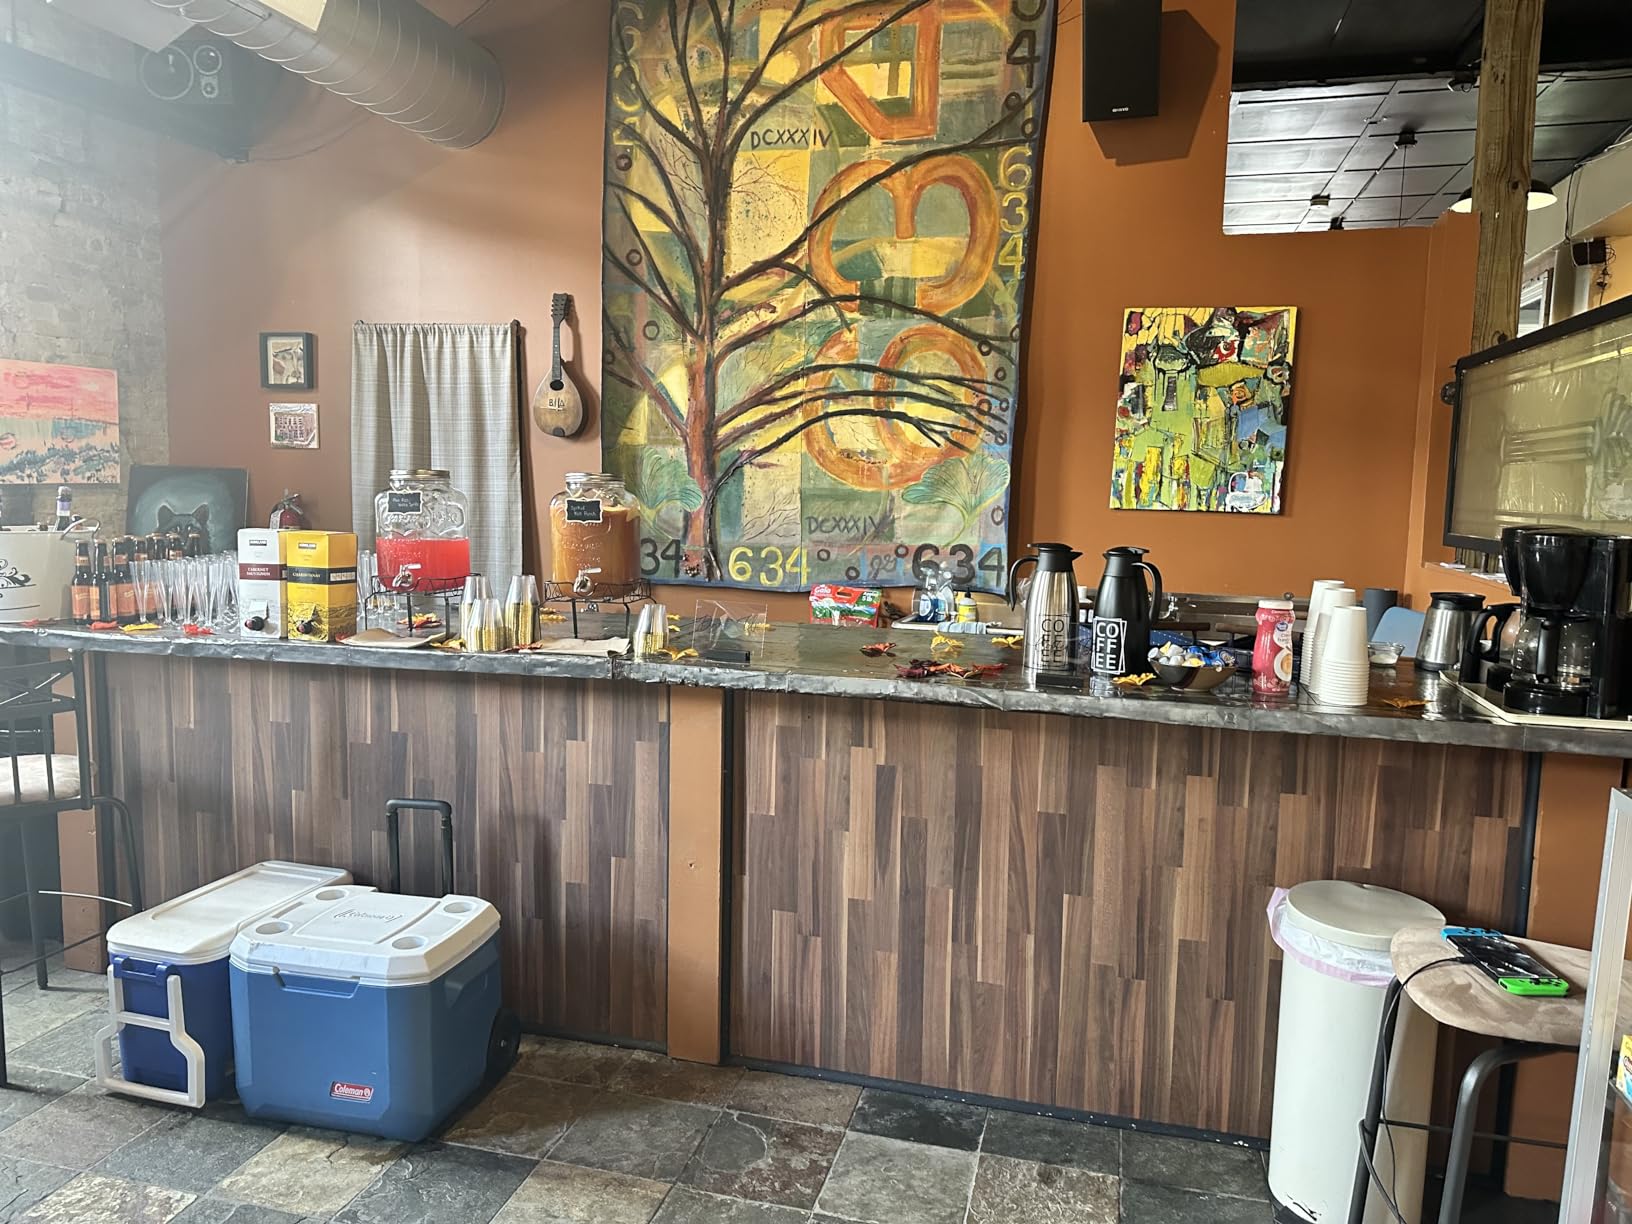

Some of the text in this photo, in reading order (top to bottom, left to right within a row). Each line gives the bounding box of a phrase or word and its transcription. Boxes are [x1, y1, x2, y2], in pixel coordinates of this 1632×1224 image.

[751, 128, 834, 150] DCXXXIV
[728, 546, 812, 587] 634
[912, 543, 1005, 587] 634
[1041, 618, 1065, 633] CO
[1096, 621, 1119, 638] CO
[1096, 637, 1117, 654] FF
[1095, 652, 1117, 670] EE
[334, 1083, 363, 1096] Coleman
